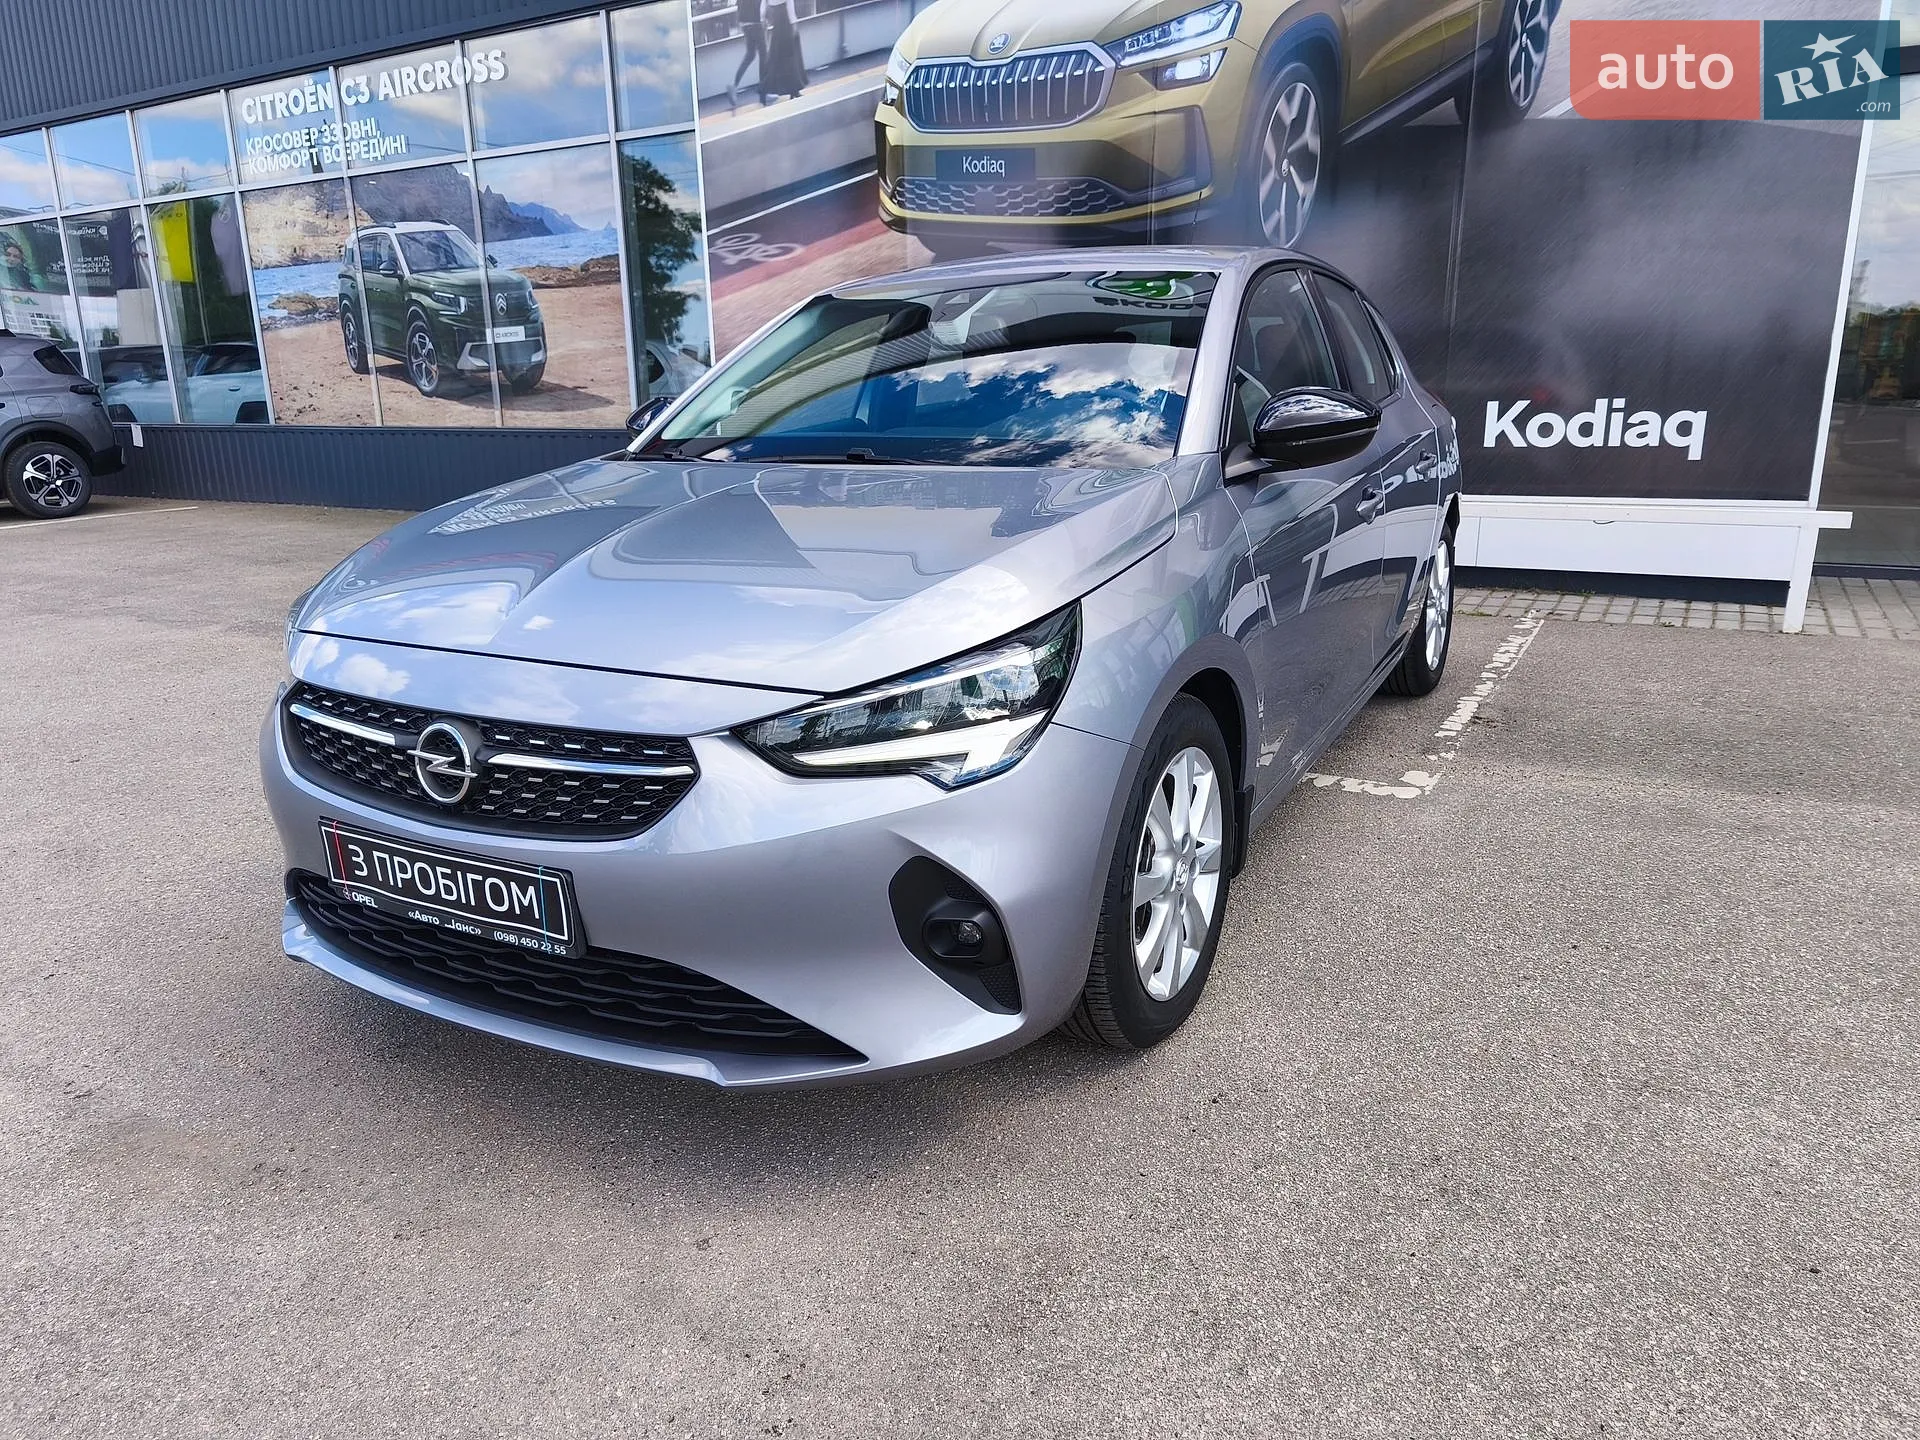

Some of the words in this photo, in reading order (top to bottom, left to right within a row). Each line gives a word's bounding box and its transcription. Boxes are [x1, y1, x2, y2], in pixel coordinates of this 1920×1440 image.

[242, 78, 335, 124] CITROËN
[340, 76, 370, 106] C3
[379, 49, 506, 101] AIRCROSS
[245, 127, 319, 156] КРОСОВЕР
[249, 148, 319, 175] КОМФОРТ
[962, 156, 1006, 178] Kodiaq
[1483, 398, 1708, 461] Kodiaq
[372, 851, 541, 920] ПРОБІГОМ
[352, 892, 379, 908] OPEL
[494, 930, 519, 946] (098)
[520, 937, 538, 948] 450
[554, 945, 567, 955] 55
